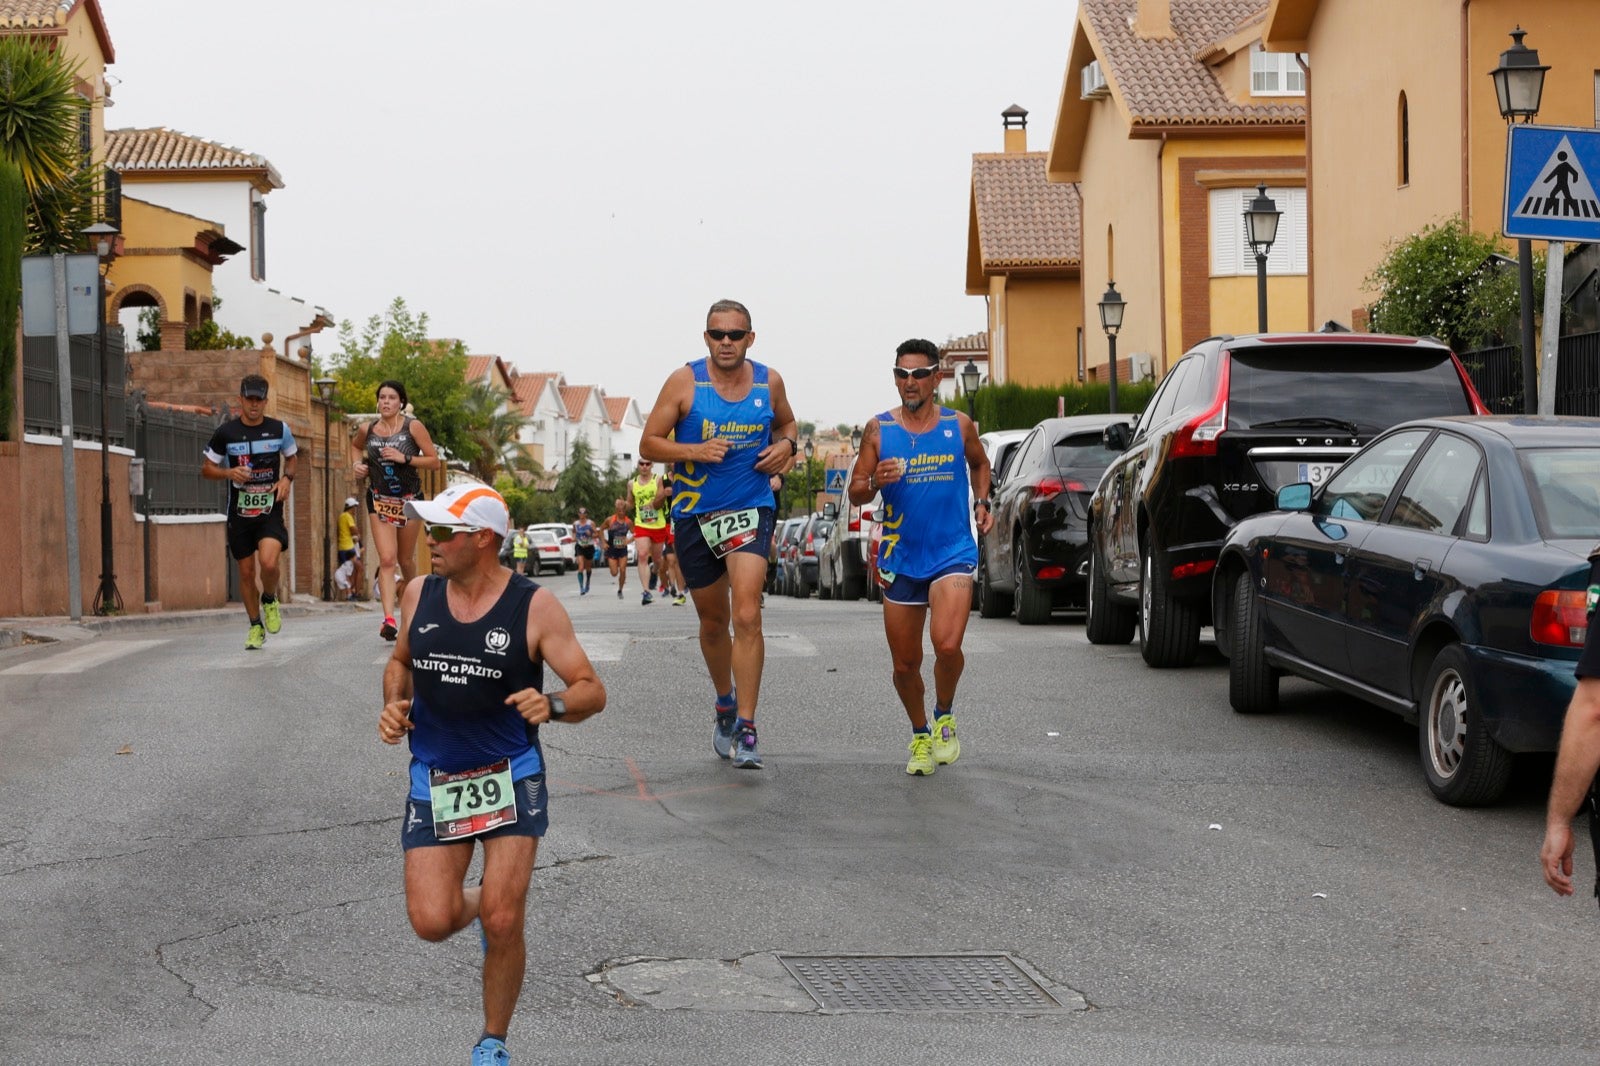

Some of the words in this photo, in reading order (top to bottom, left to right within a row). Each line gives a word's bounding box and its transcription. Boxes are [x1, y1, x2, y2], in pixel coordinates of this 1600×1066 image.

[720, 421, 764, 435] olimpo
[909, 453, 955, 466] olimpo
[909, 465, 937, 473] deportes
[929, 473, 954, 481] RUNNING
[244, 494, 268, 506] 865
[711, 513, 751, 539] 725
[490, 632, 507, 647] 30
[451, 665, 459, 673] a
[461, 664, 502, 679] PAZITO
[441, 674, 467, 685] Motril
[447, 779, 501, 813] 739
